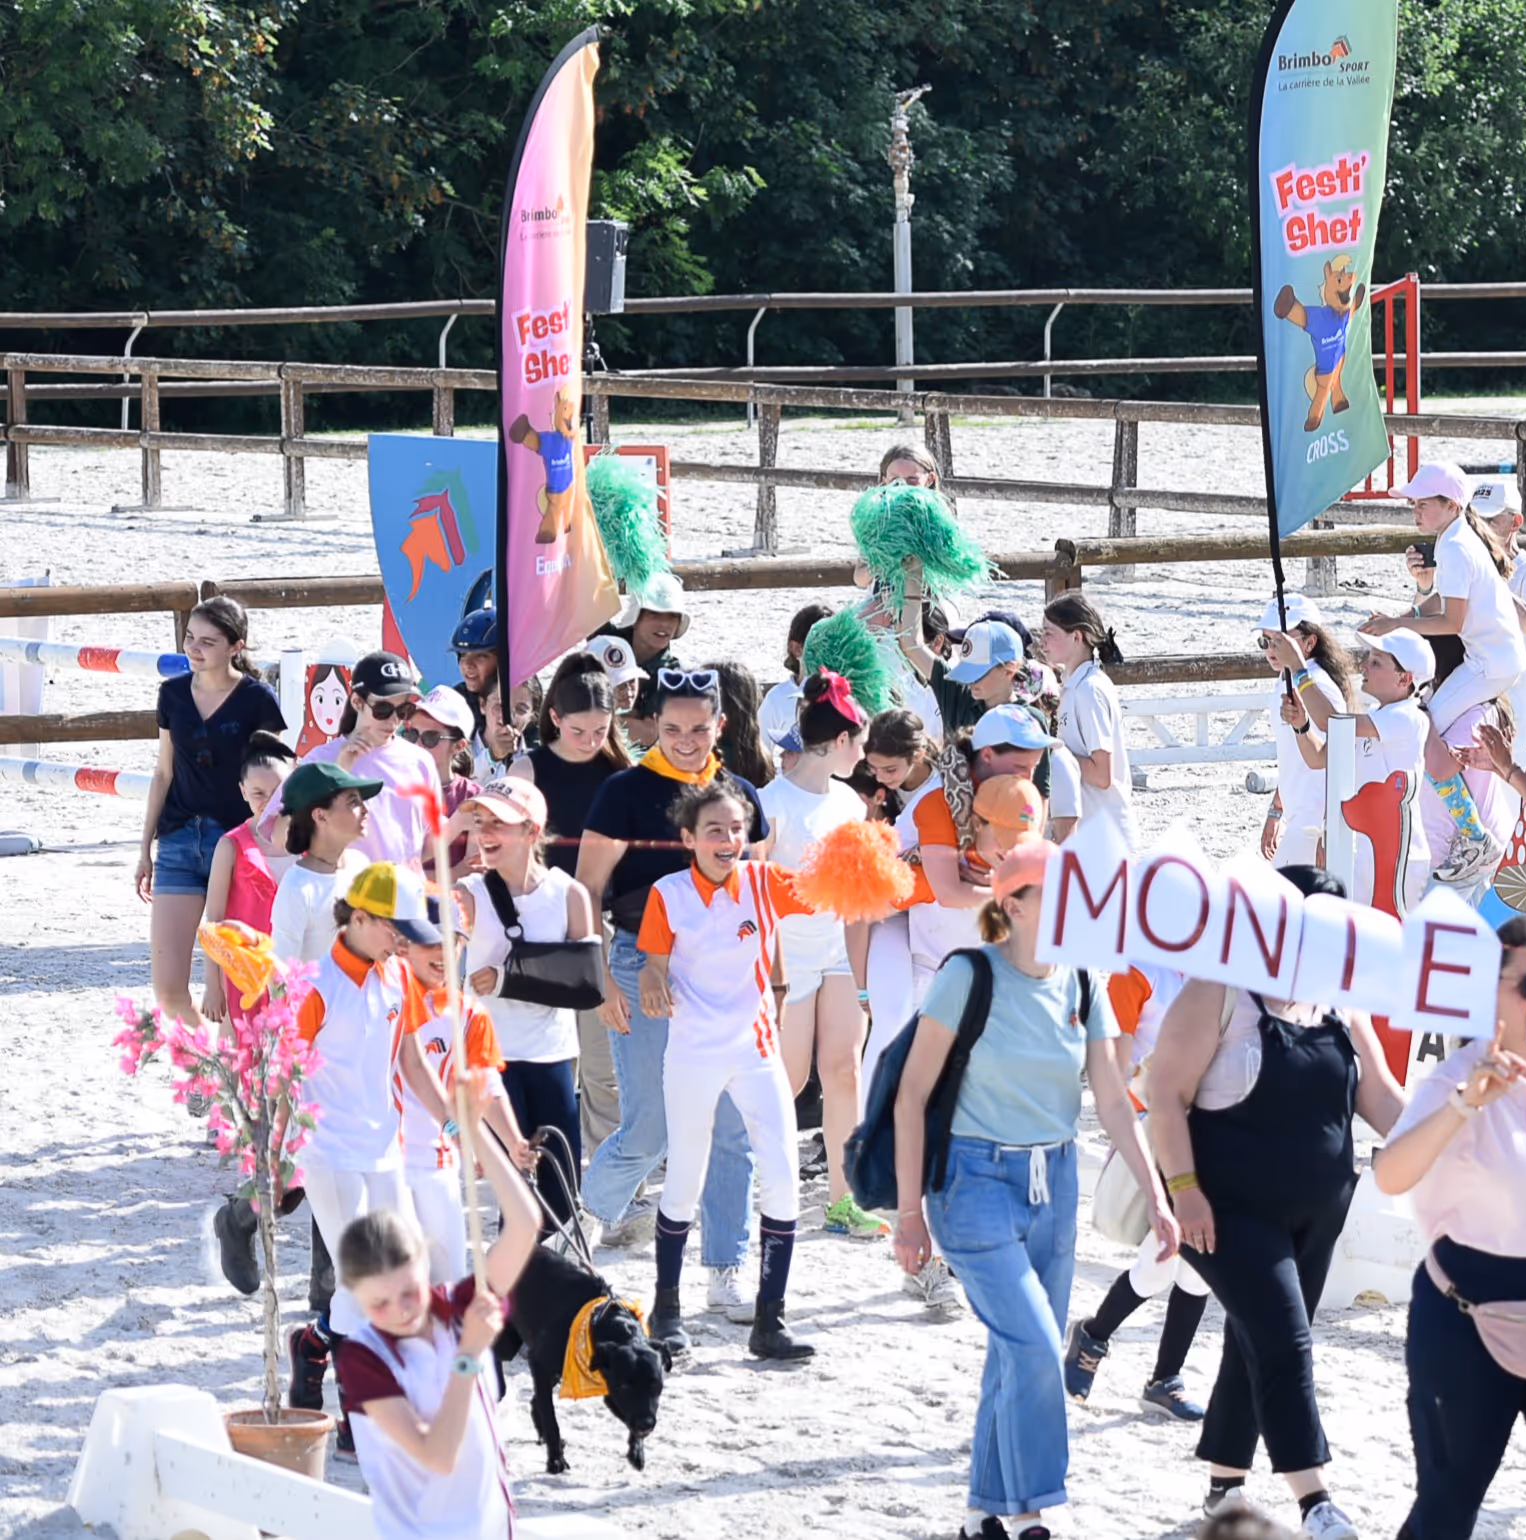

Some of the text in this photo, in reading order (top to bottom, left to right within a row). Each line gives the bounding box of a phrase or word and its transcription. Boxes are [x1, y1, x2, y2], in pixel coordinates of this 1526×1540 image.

[1278, 51, 1370, 73] Brimbo SPORT
[1278, 75, 1370, 92] La carrière de la Vallée
[1275, 155, 1367, 210] Festi'
[520, 207, 558, 223] Brimbo
[1286, 208, 1361, 252] Shet
[1306, 429, 1350, 464] CROSS
